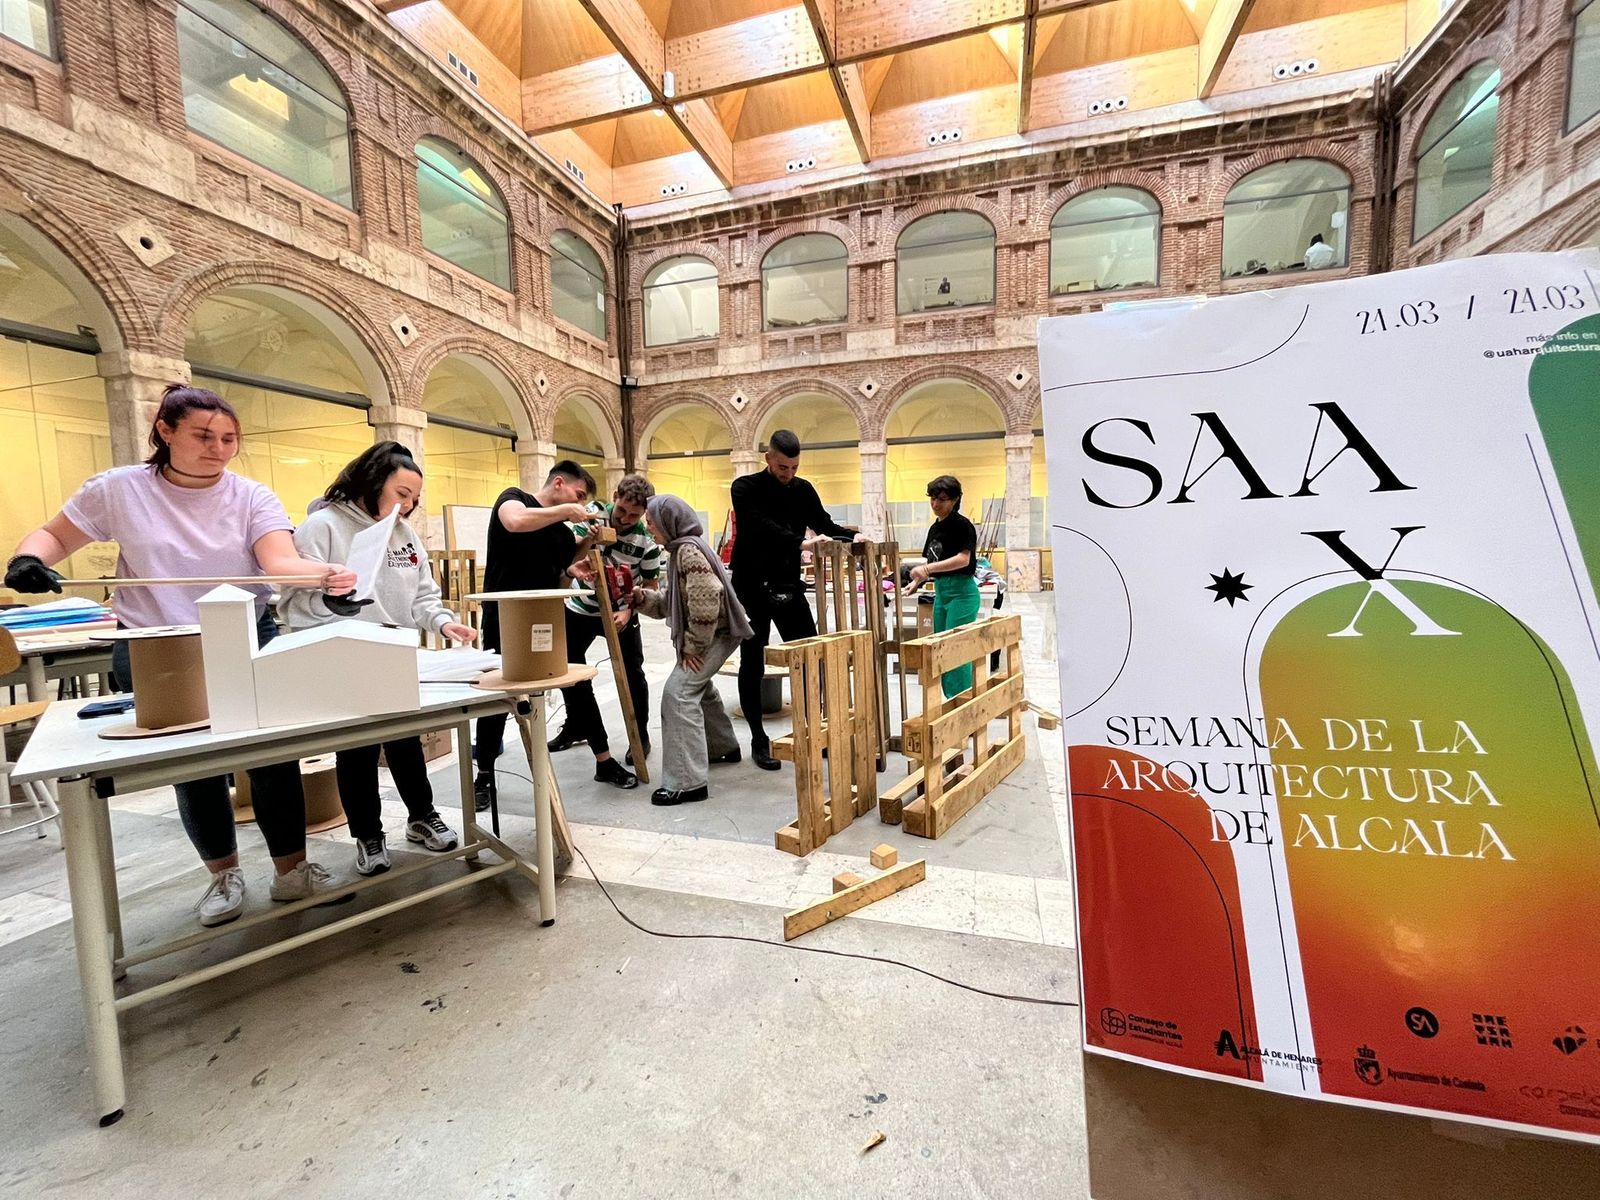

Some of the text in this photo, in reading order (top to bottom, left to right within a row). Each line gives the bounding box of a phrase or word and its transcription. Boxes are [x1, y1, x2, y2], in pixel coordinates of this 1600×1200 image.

[1356, 300, 1439, 335] 21.03
[1526, 331, 1598, 343] más info en
[1081, 401, 1418, 509] SAA
[1300, 525, 1463, 637] X
[1106, 715, 1488, 755] SEMANA DE LA
[1101, 759, 1503, 806] ARQUITECTURA
[1207, 808, 1517, 861] DE ALCALA
[1128, 1013, 1163, 1028] Consejo
[1129, 1023, 1182, 1041] Estudiantes
[1271, 1050, 1282, 1059] DE
[1284, 1053, 1323, 1066] HENARES
